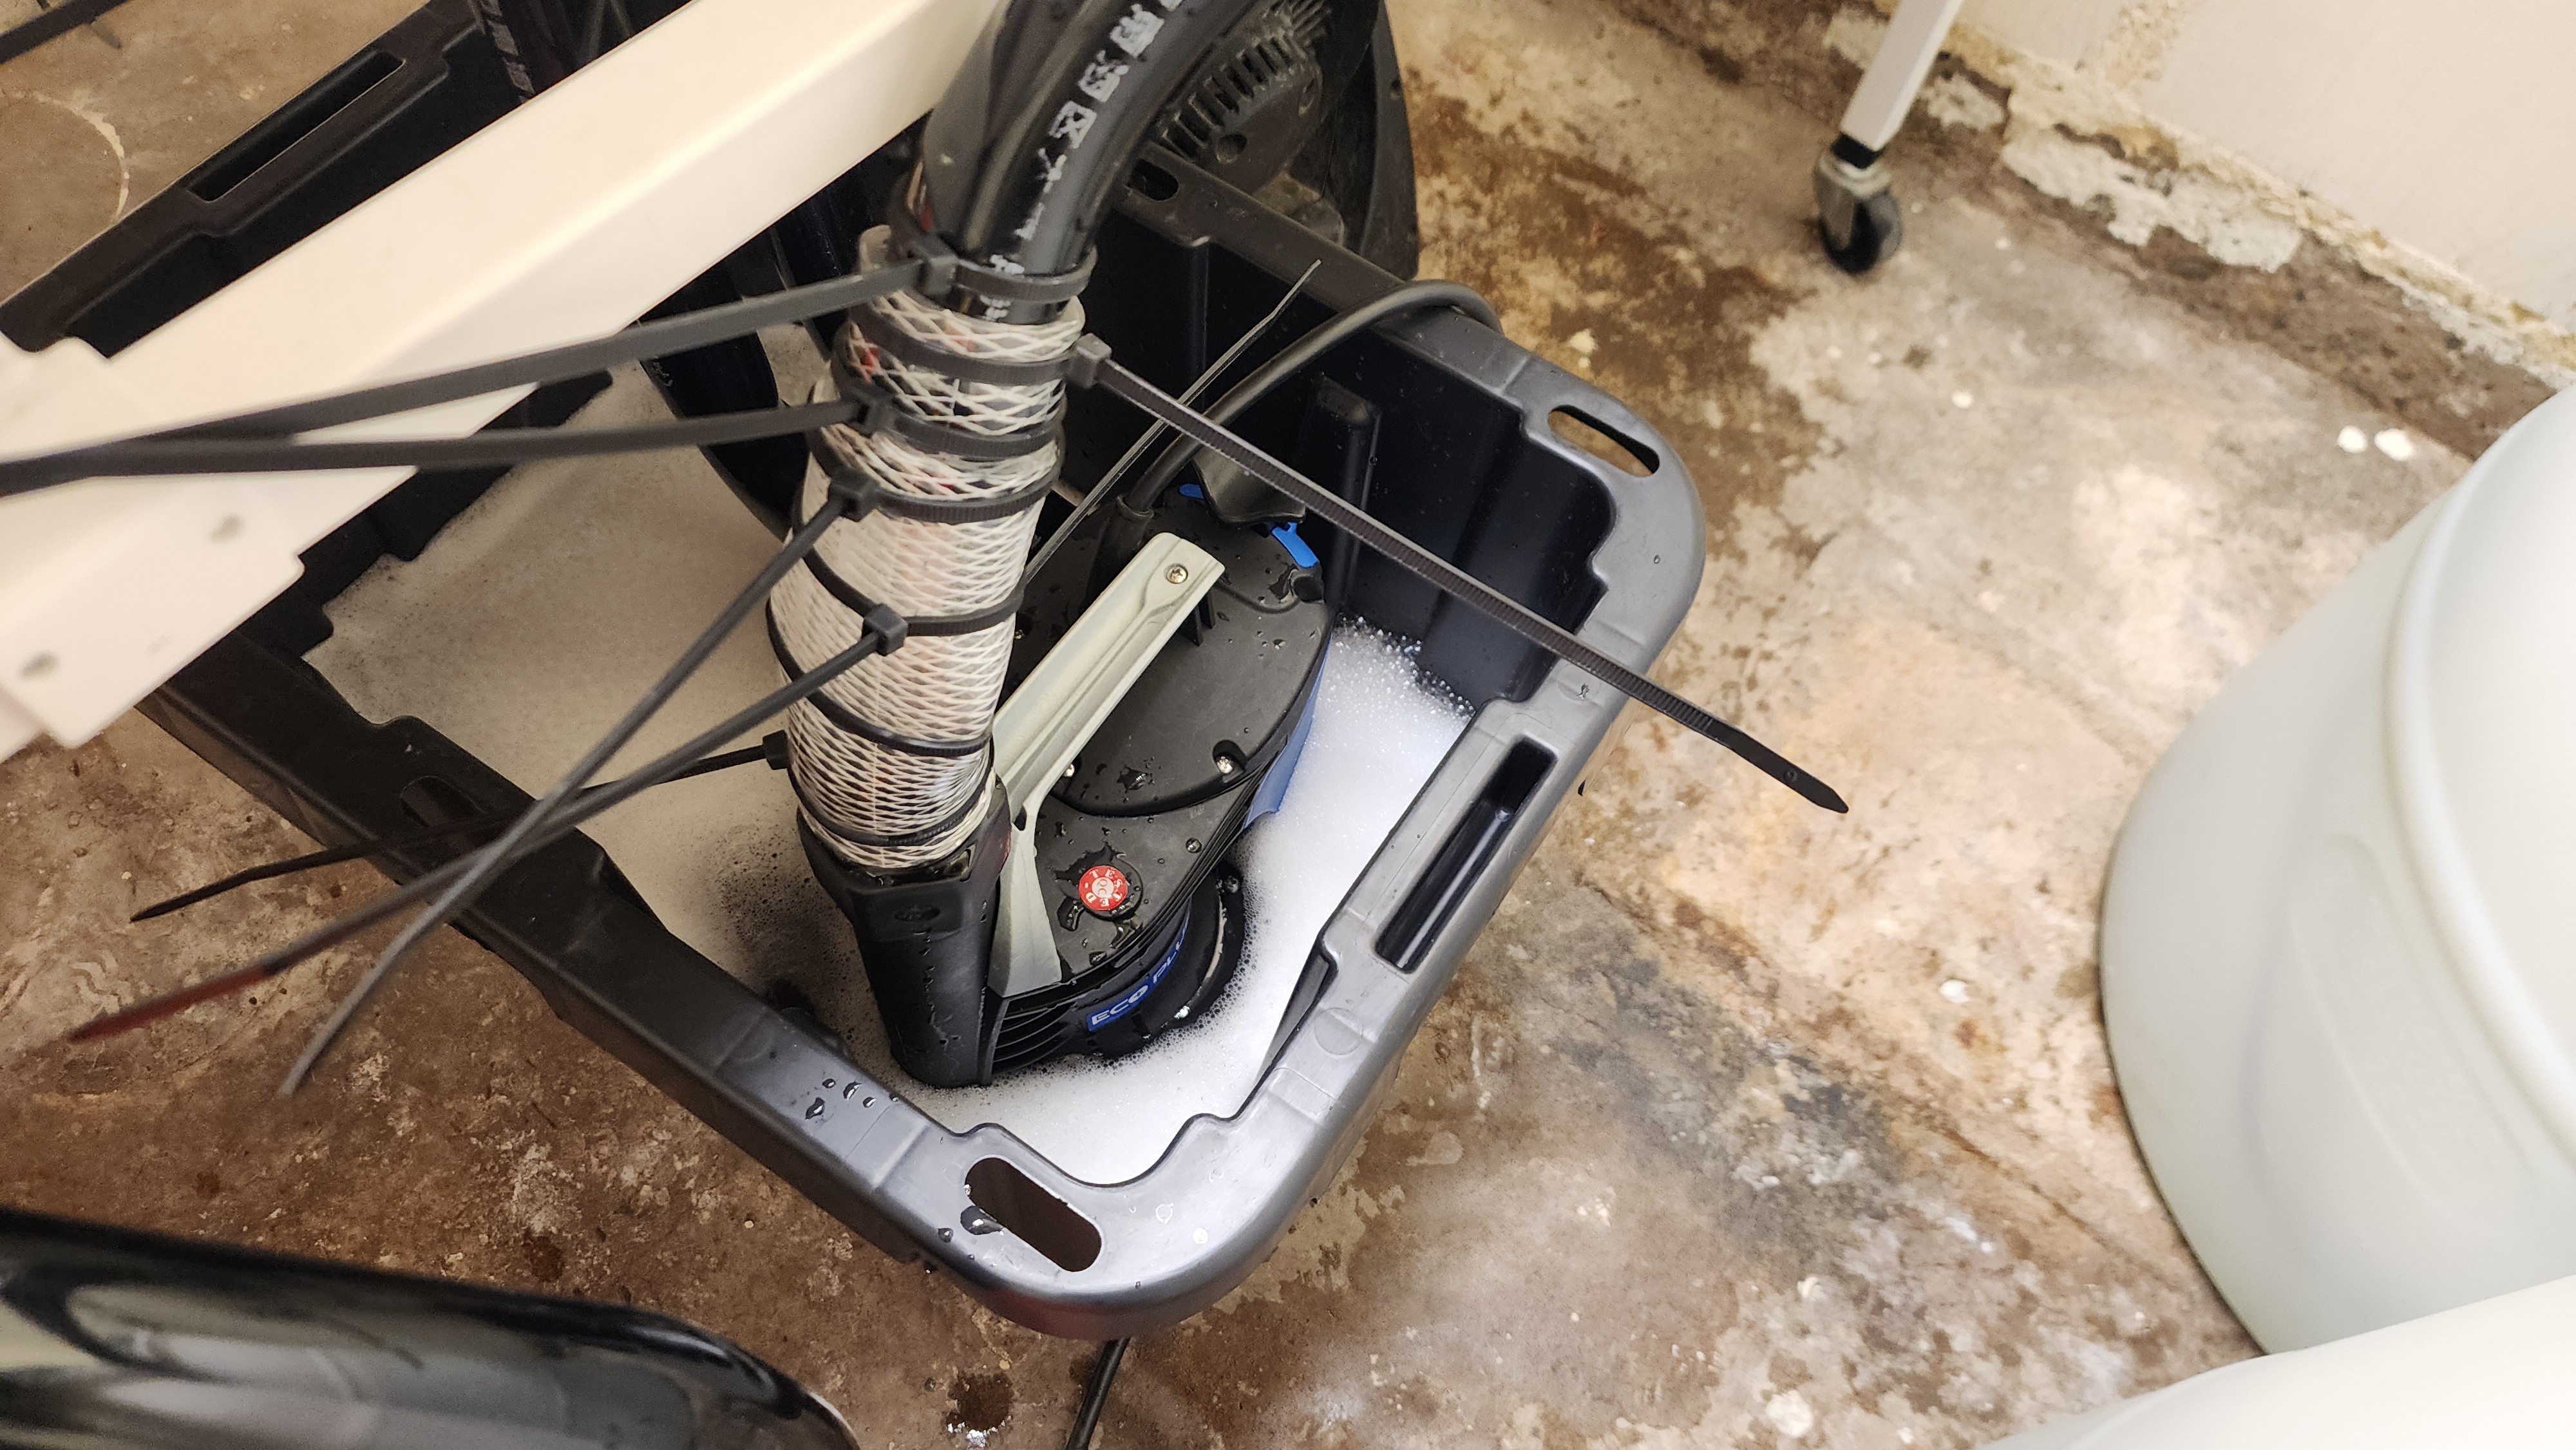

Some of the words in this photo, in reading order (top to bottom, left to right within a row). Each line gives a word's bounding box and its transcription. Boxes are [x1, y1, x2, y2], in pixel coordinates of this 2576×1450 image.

[1086, 869, 1124, 907] TESTED
[1097, 878, 1108, 896] QC
[1092, 984, 1149, 1025] ECO
